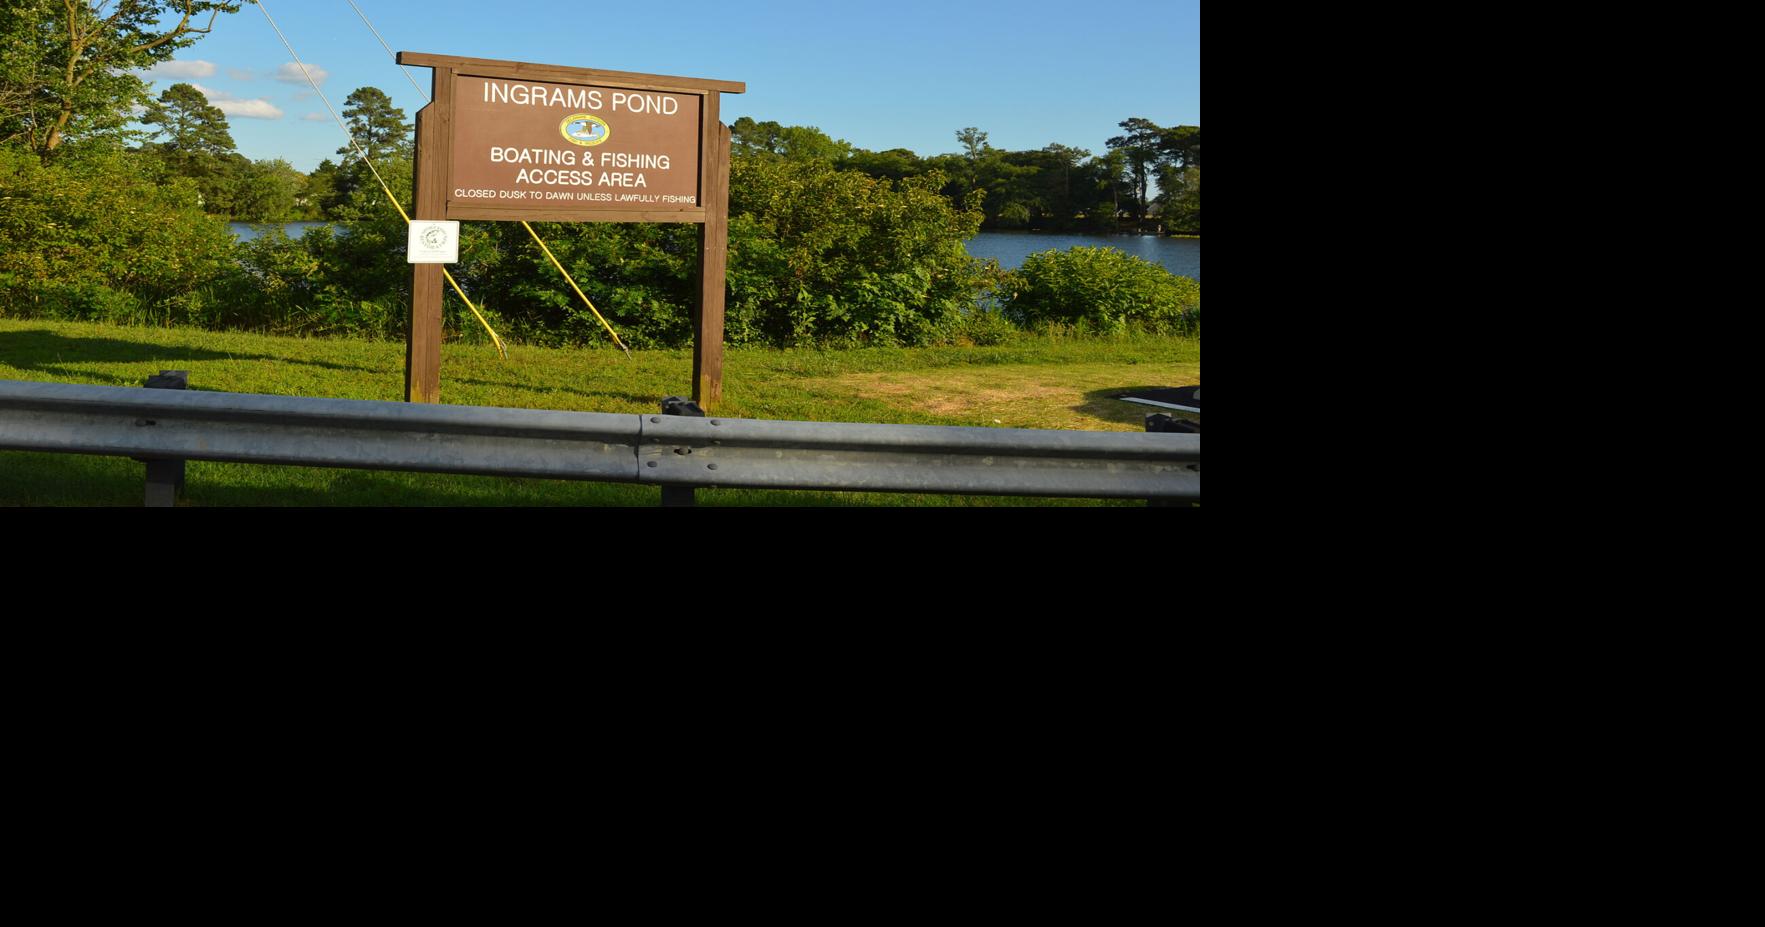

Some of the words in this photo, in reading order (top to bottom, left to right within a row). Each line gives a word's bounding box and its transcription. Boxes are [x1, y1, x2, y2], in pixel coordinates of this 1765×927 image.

[483, 81, 603, 111] INGRAMS
[611, 92, 679, 116] POND
[490, 146, 576, 166] BOATING
[581, 150, 595, 167] &
[600, 152, 670, 170] FISHING
[515, 167, 593, 186] ACCESS
[597, 171, 647, 188] AREA
[454, 188, 497, 199] CLOSED
[499, 190, 527, 199] DUSK
[529, 190, 543, 200] TO
[545, 191, 574, 201] DAWN
[576, 192, 613, 202] UNLESS
[614, 193, 660, 203] LAWFULLY
[662, 194, 697, 204] FISHING
